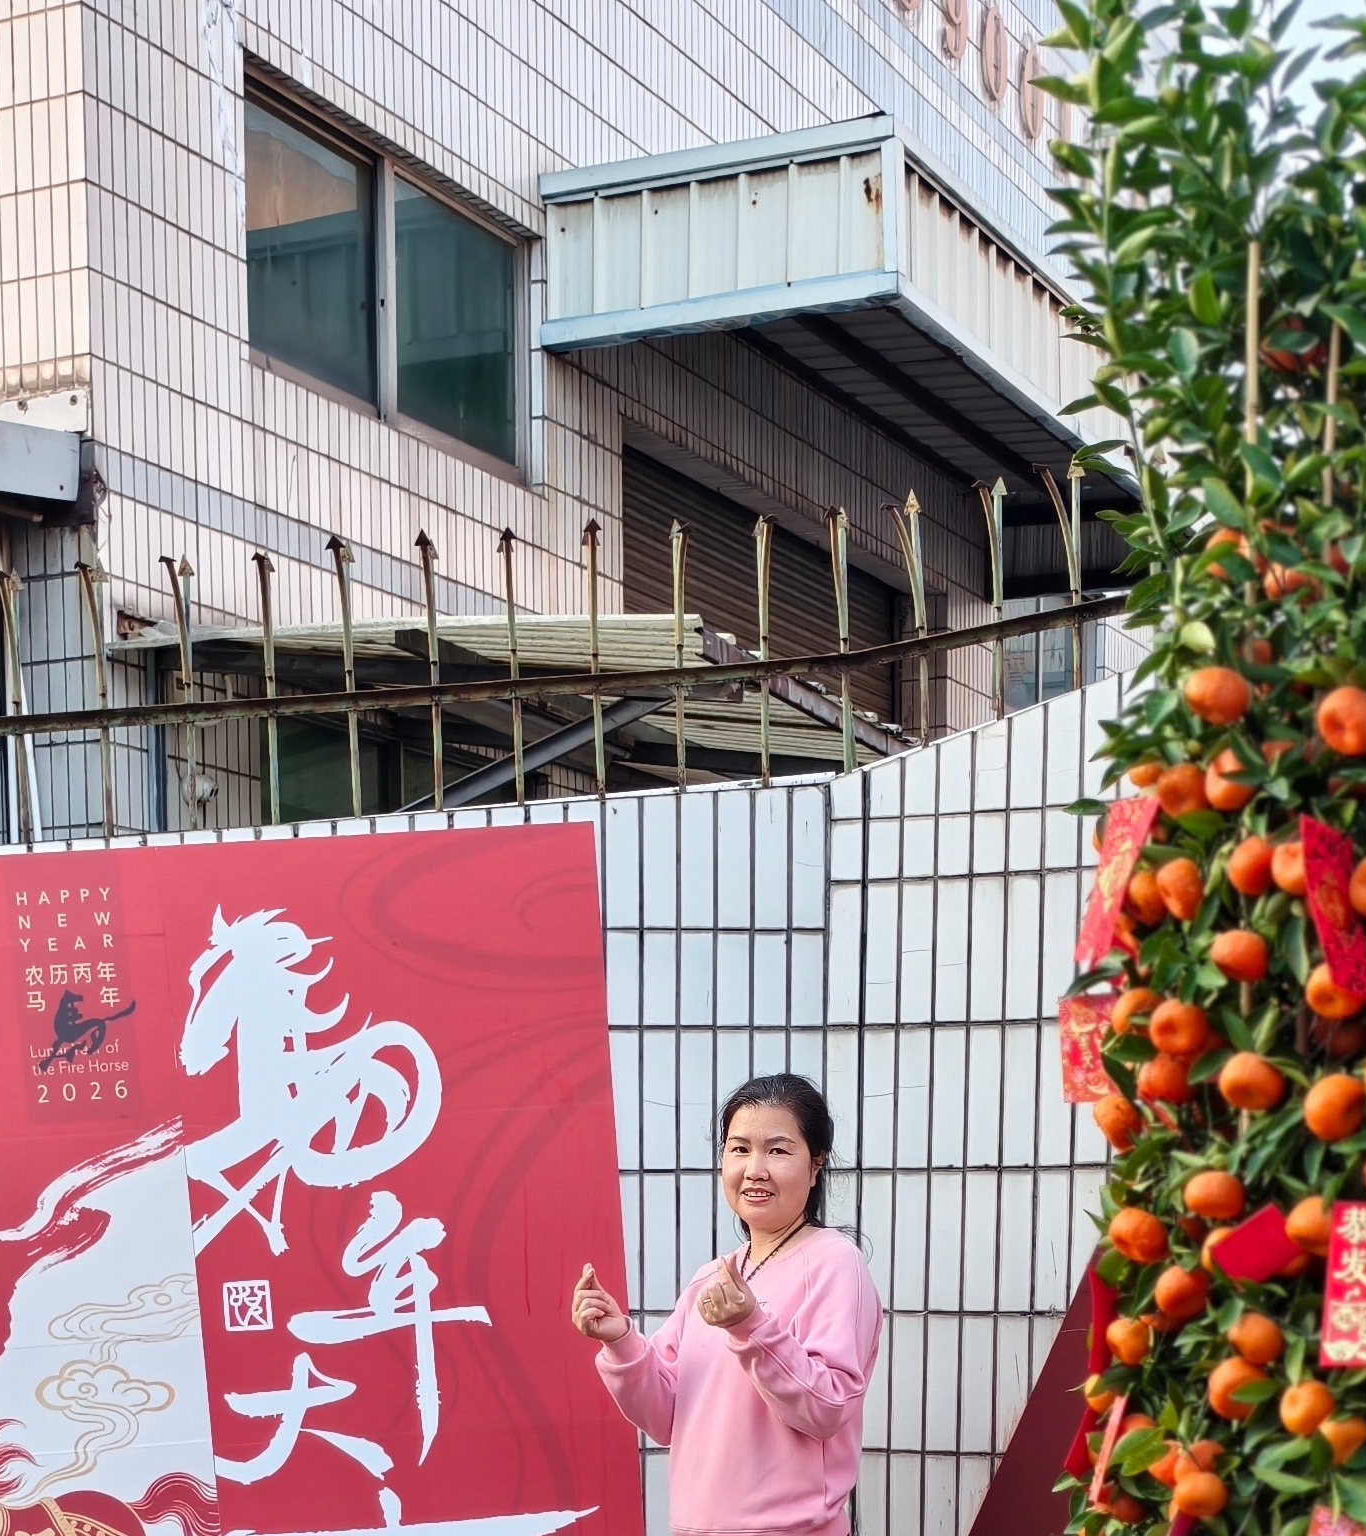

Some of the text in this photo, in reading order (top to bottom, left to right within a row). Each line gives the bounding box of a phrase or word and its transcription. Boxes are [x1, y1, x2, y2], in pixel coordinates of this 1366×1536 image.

[16, 887, 110, 906] HAPPY
[18, 911, 111, 930] NEW
[19, 934, 114, 952] YEAR
[105, 1038, 119, 1053] of
[32, 1059, 129, 1076] te Fire Horse
[37, 1080, 128, 1104] 2026
